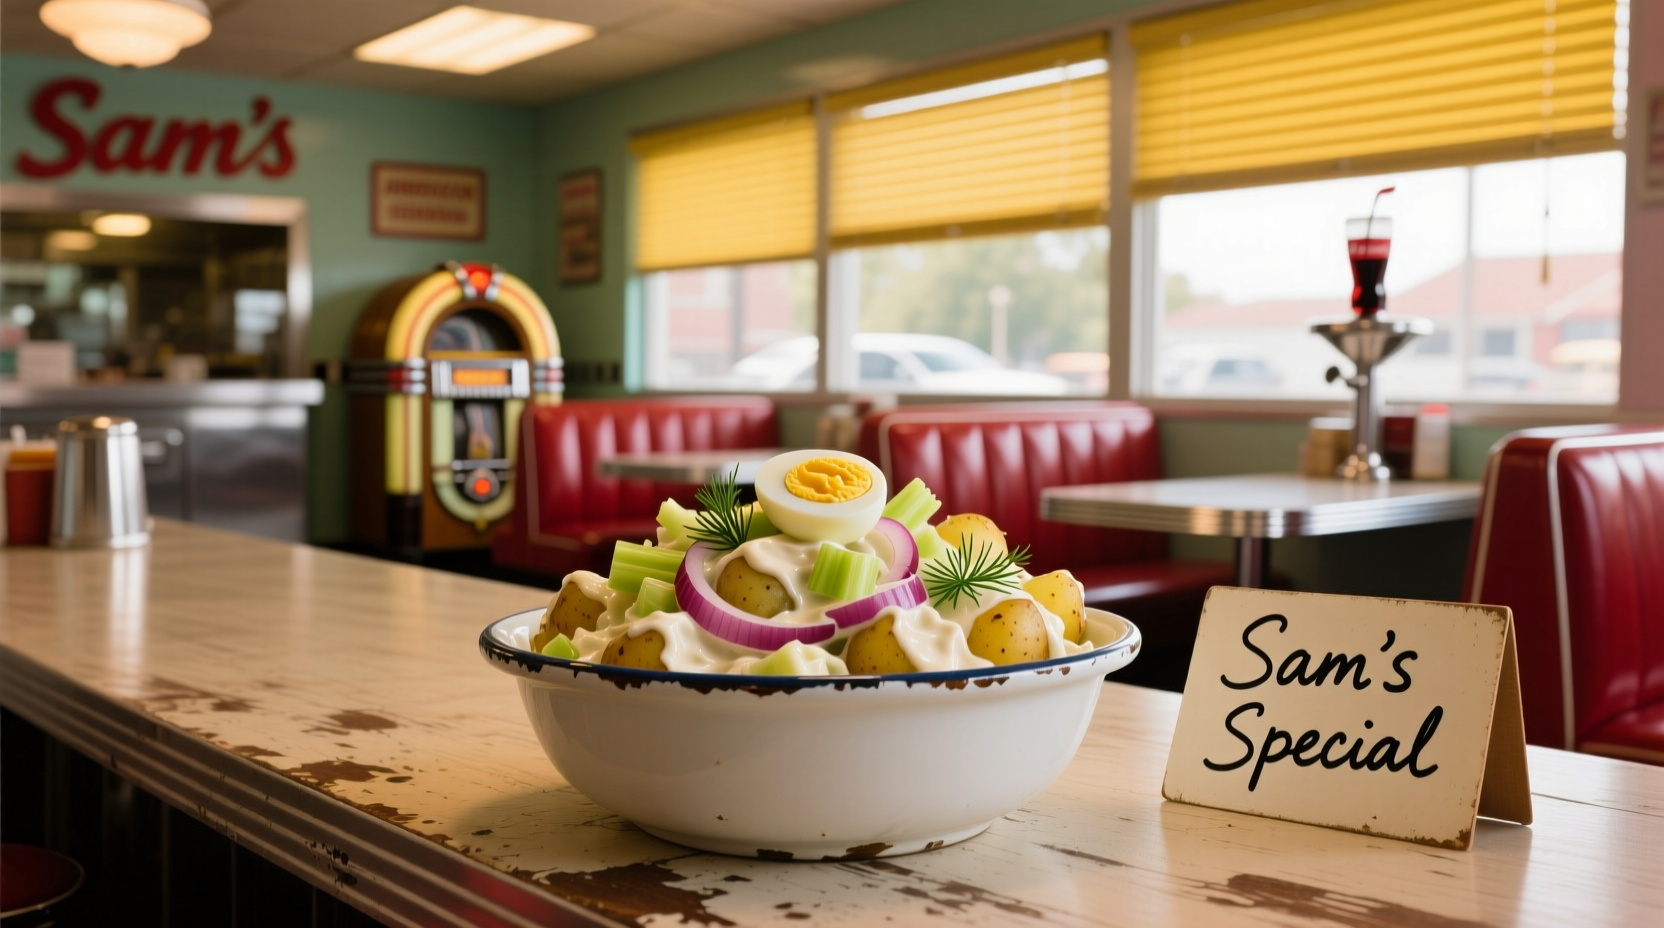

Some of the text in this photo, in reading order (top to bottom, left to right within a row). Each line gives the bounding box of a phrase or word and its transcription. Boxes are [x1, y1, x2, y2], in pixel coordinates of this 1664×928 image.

[17, 78, 295, 180] Sam's
[1220, 613, 1418, 693] Sam's
[1203, 701, 1444, 792] Special
